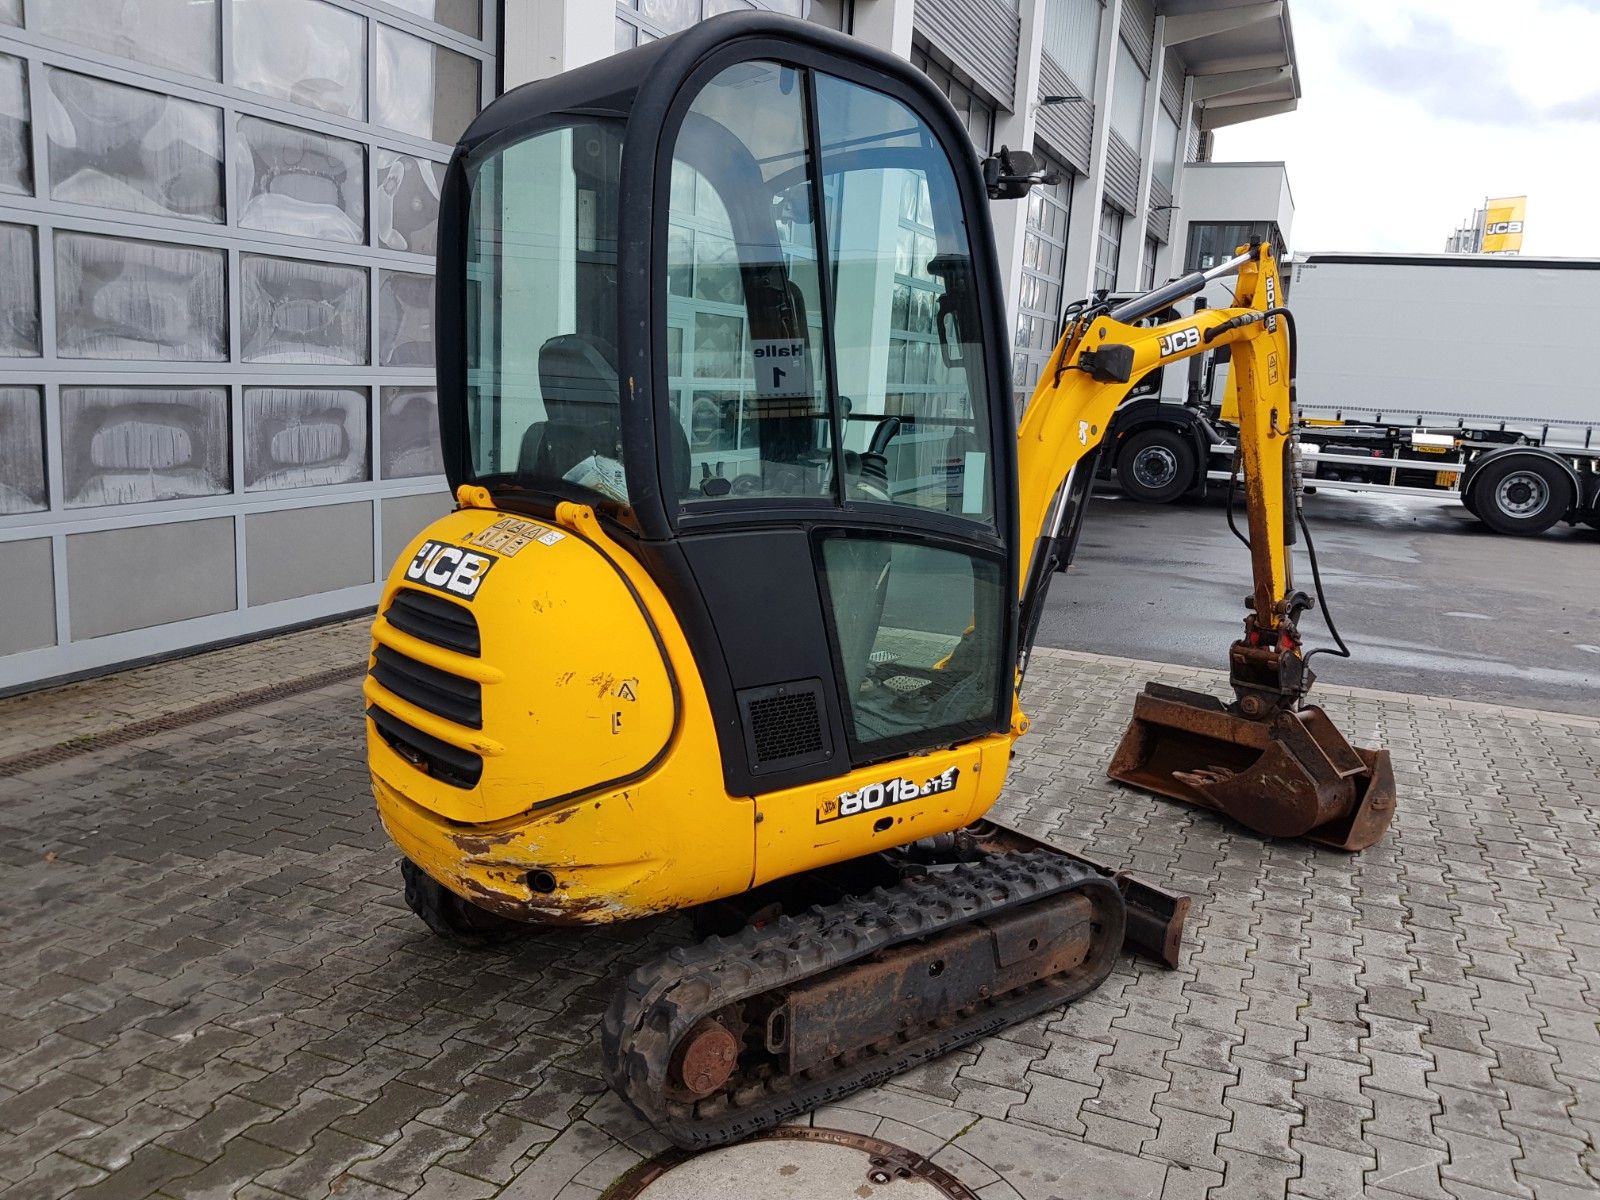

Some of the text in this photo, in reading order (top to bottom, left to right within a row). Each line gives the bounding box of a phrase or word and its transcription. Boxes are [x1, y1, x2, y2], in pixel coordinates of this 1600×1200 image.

[1487, 221, 1522, 235] JCB
[1160, 328, 1200, 356] JCB
[408, 542, 491, 596] JCB
